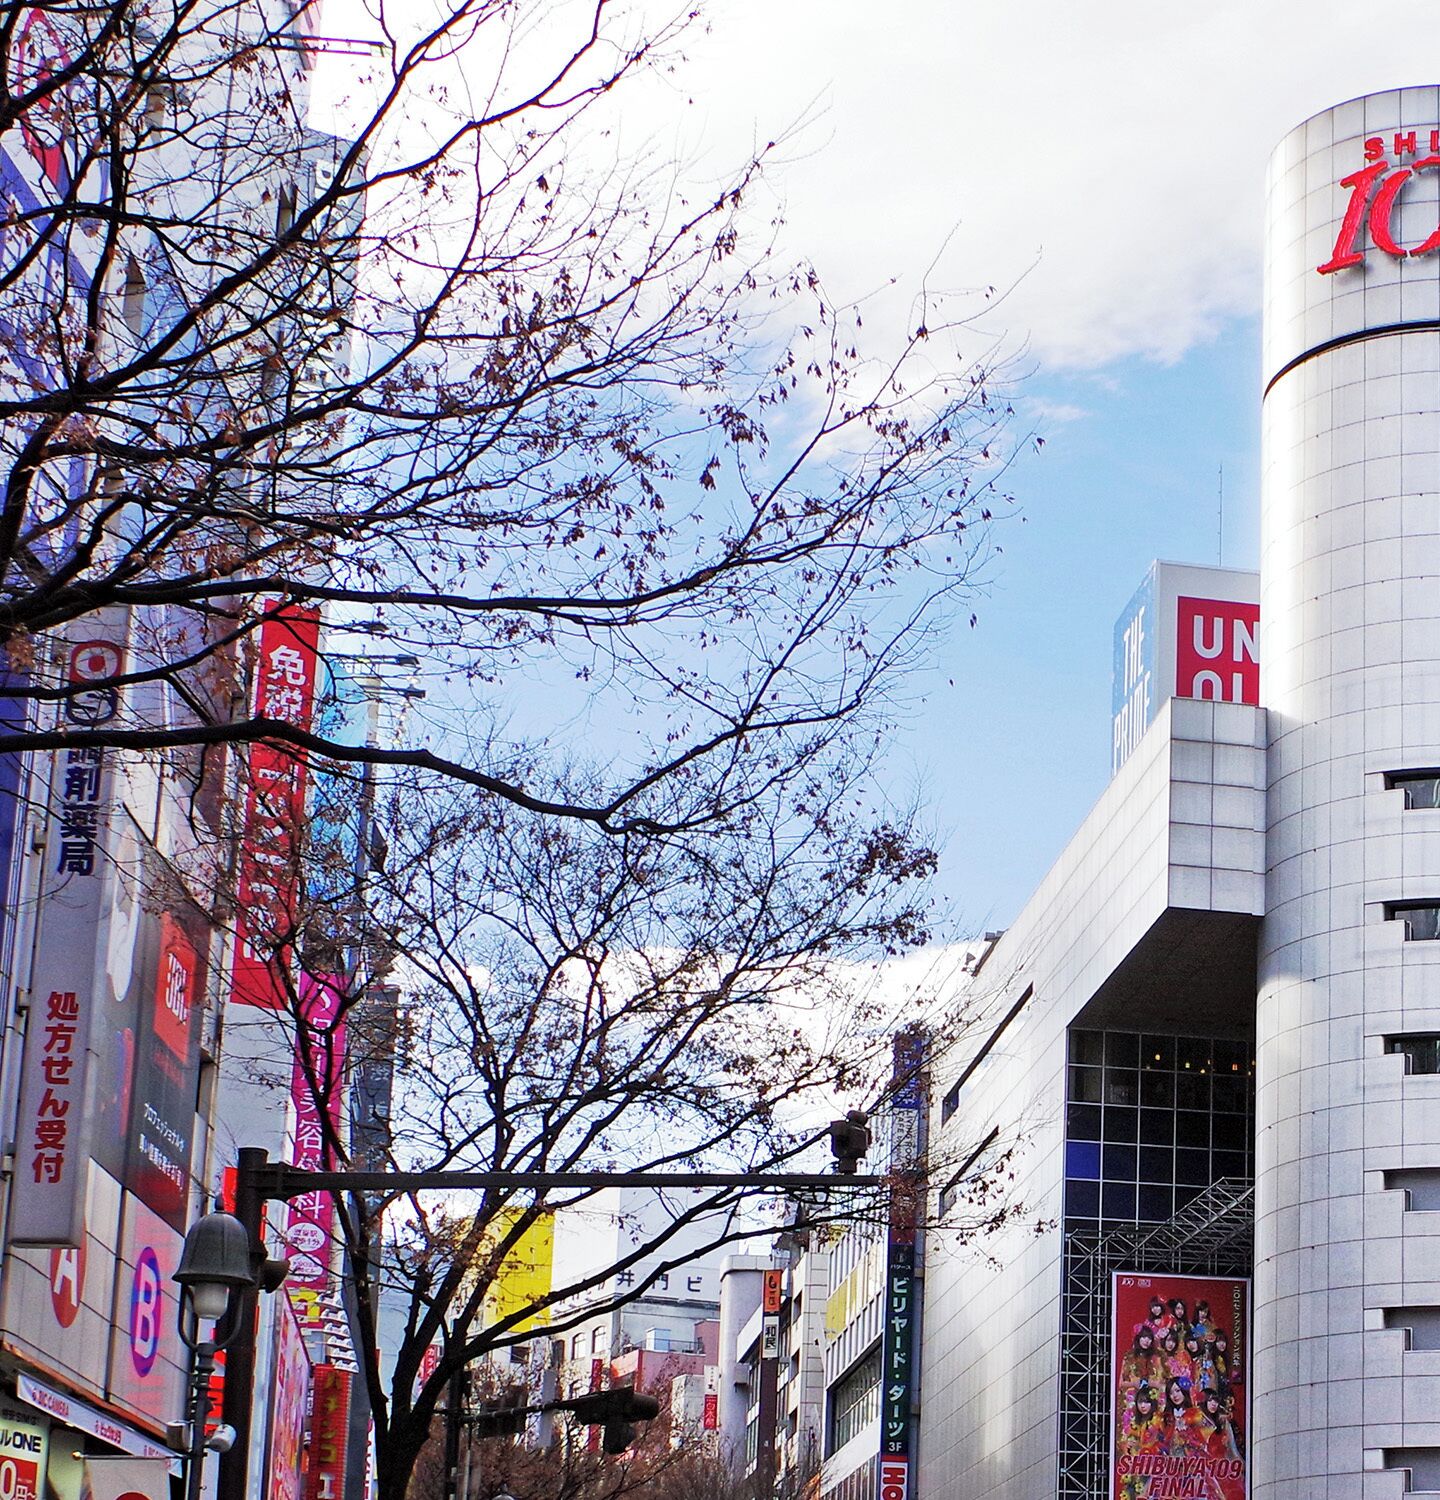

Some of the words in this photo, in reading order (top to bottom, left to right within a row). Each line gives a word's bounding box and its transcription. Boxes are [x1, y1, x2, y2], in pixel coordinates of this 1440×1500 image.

[1123, 606, 1145, 696] THE
[32, 991, 79, 1184] 処方せん受付
[134, 1262, 157, 1359] B
[888, 1277, 909, 1437] ビリヤード・ダーツ
[889, 1442, 903, 1452] 3F
[1118, 1454, 1243, 1479] SHIBUYA109
[1149, 1475, 1207, 1498] FINAL
